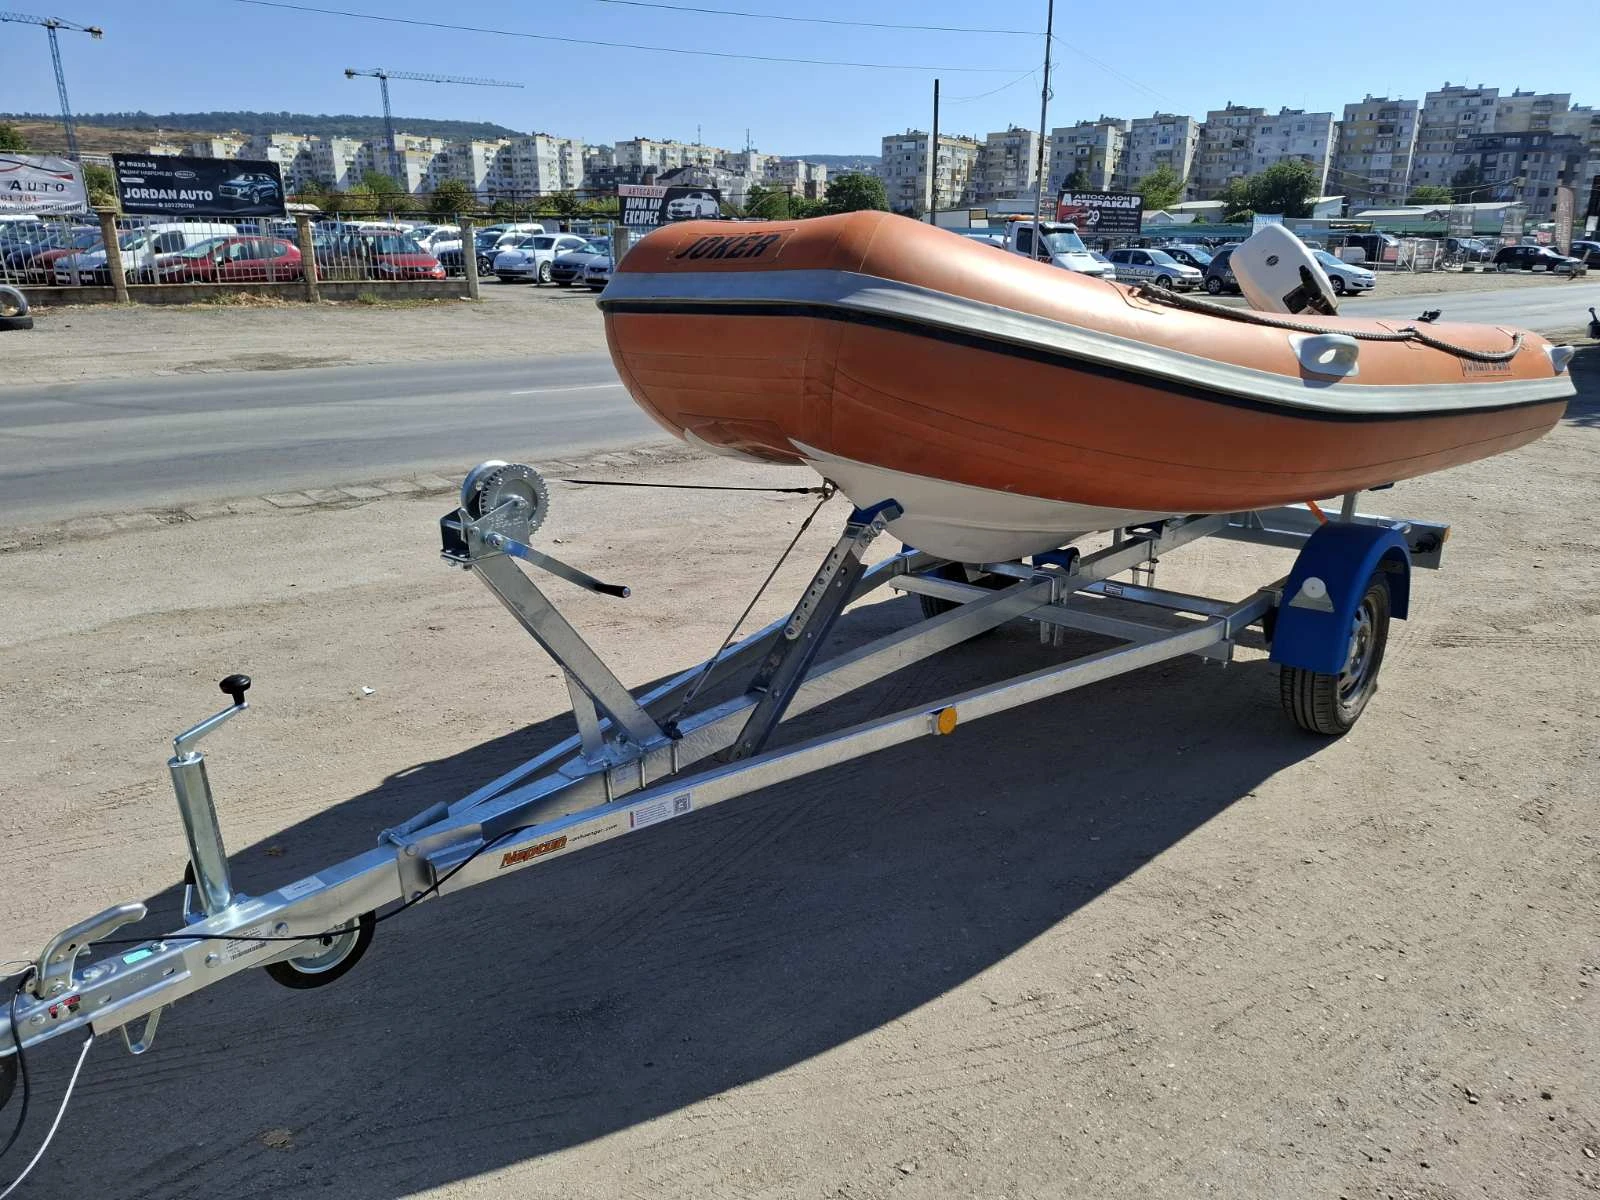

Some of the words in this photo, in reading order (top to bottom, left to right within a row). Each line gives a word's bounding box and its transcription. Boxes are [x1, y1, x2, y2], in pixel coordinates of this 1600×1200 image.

[10, 180, 65, 192] AUTO
[124, 188, 177, 199] JORDAN
[179, 190, 213, 201] AUTO
[1062, 193, 1141, 208] АСТРАКАР
[676, 235, 779, 259] JOKER
